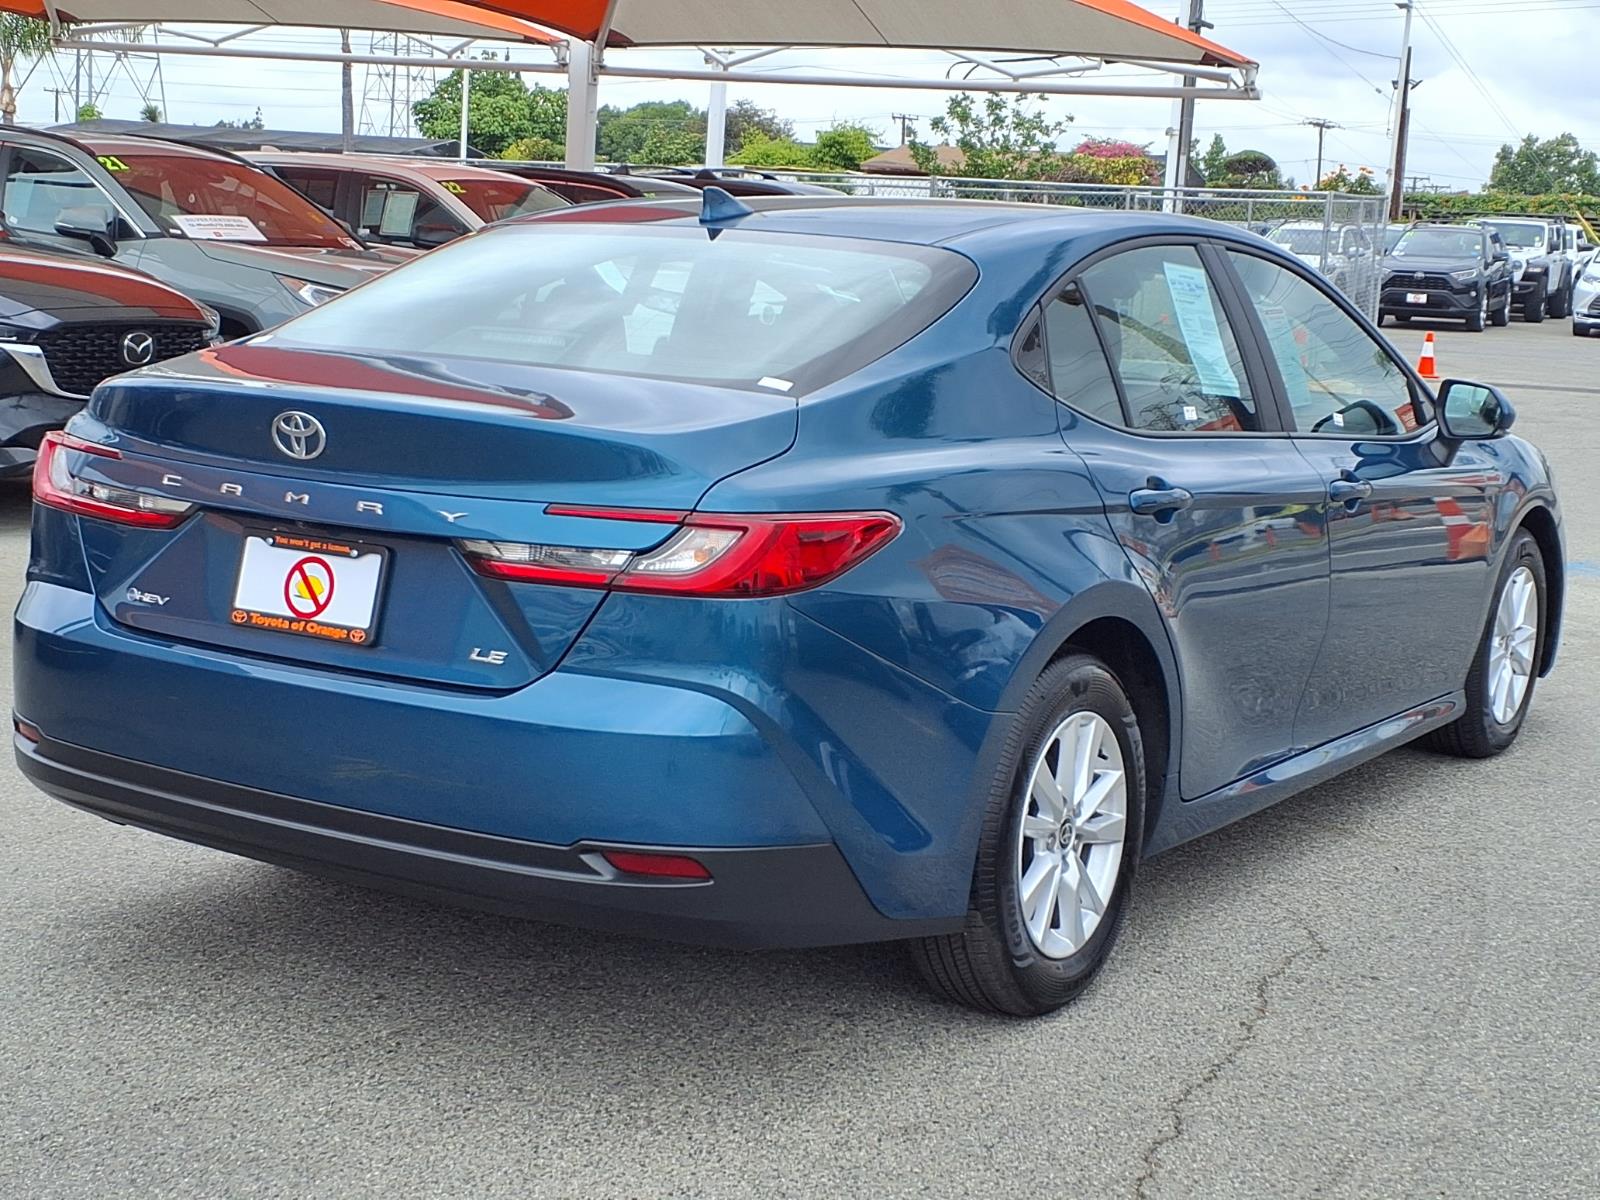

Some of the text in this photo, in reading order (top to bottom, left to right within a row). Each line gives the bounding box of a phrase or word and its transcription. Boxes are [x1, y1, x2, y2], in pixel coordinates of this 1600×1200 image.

[97, 156, 130, 170] 21
[162, 474, 468, 523] CAMRY
[250, 613, 348, 638] Toyota of Orange
[469, 647, 508, 664] LE
